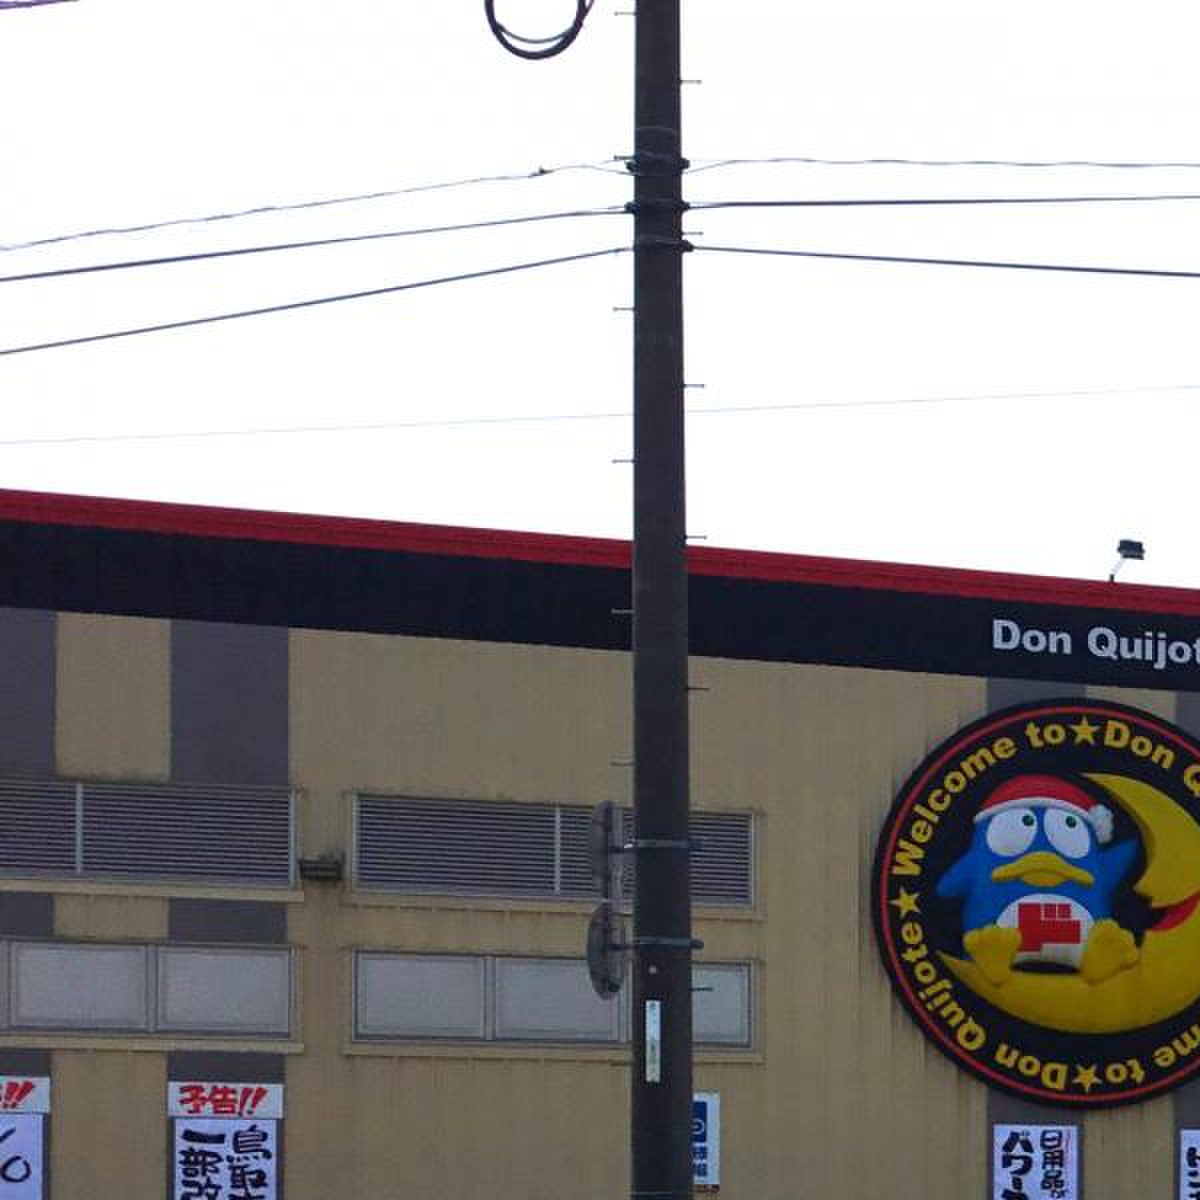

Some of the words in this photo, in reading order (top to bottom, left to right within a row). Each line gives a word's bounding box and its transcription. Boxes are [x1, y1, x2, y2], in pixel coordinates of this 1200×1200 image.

[992, 619, 1073, 655] Don
[1103, 719, 1176, 769] Don
[892, 736, 1018, 877] Welcome
[1024, 721, 1067, 748] to
[901, 921, 987, 1051] Quijote
[995, 1043, 1069, 1091] Don
[1105, 1059, 1146, 1084] to
